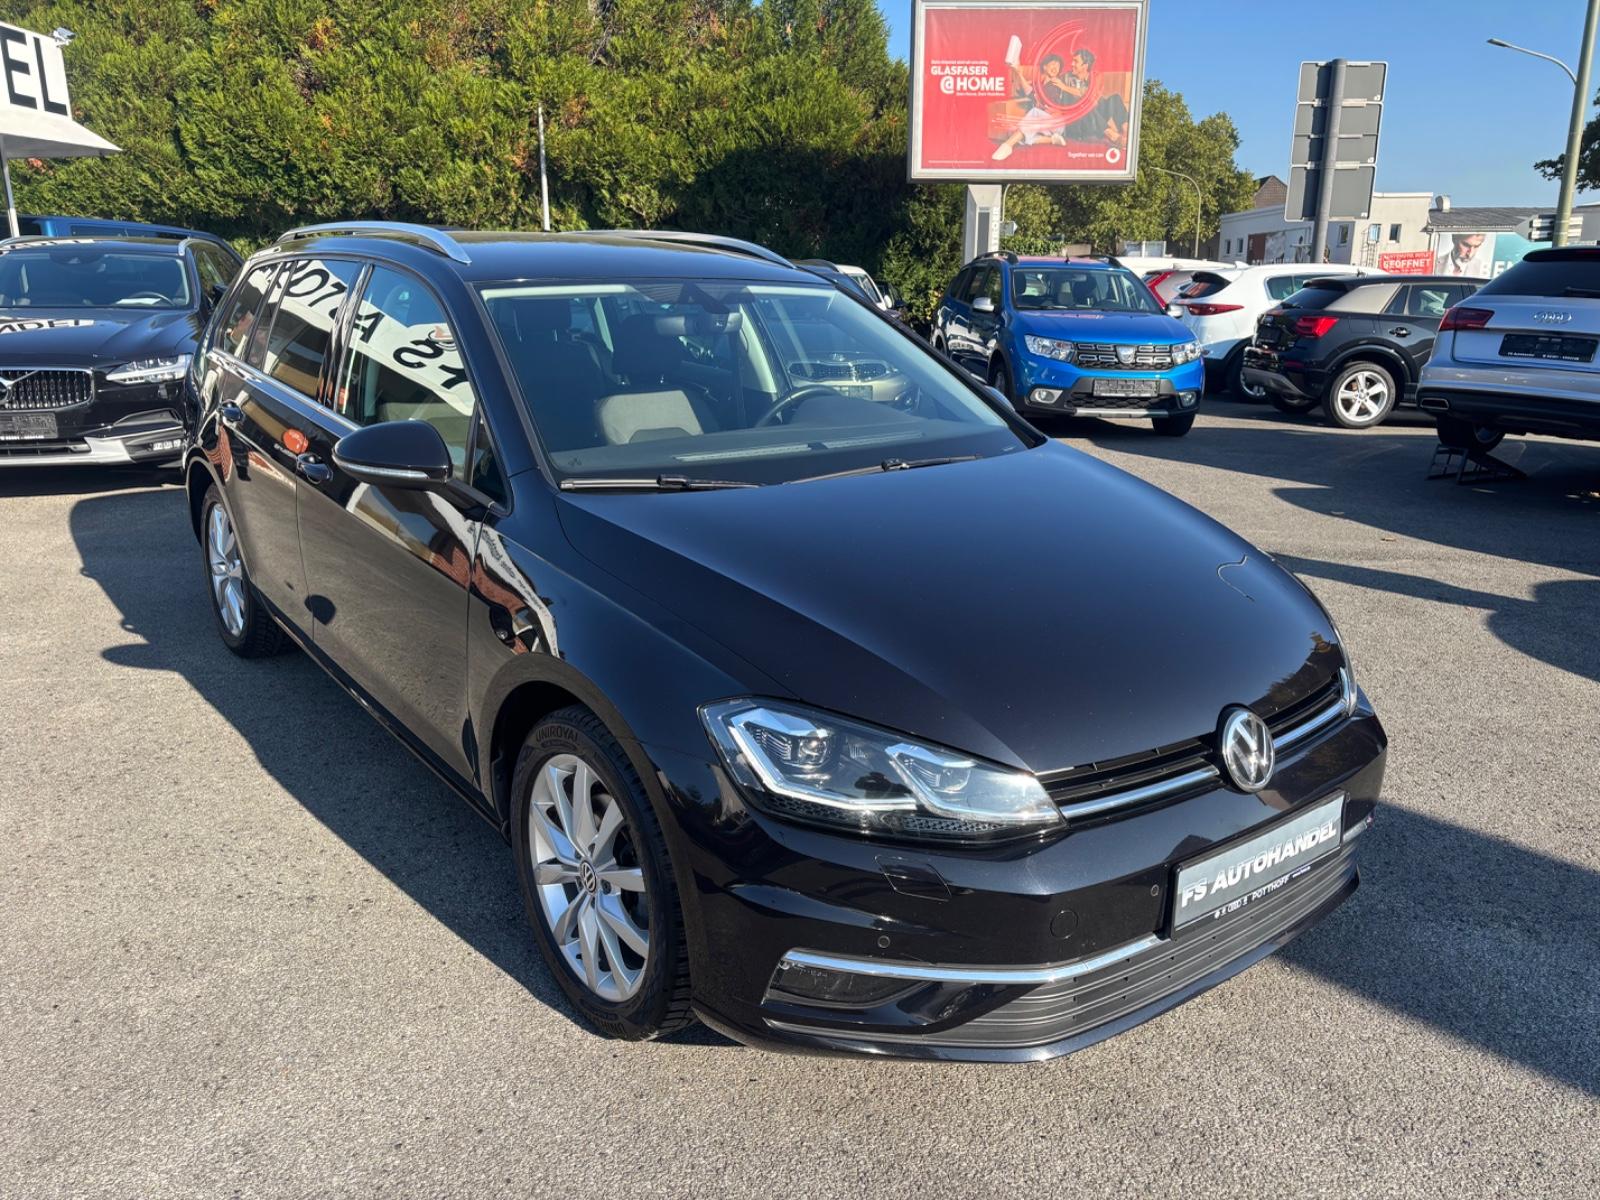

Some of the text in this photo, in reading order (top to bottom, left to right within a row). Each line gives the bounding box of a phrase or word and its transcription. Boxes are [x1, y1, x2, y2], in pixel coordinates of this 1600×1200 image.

[930, 65, 988, 76] GLASFASER
[940, 75, 1005, 94] @HOME
[1181, 877, 1209, 908] FS
[1210, 819, 1337, 894] AUTOHANDEL
